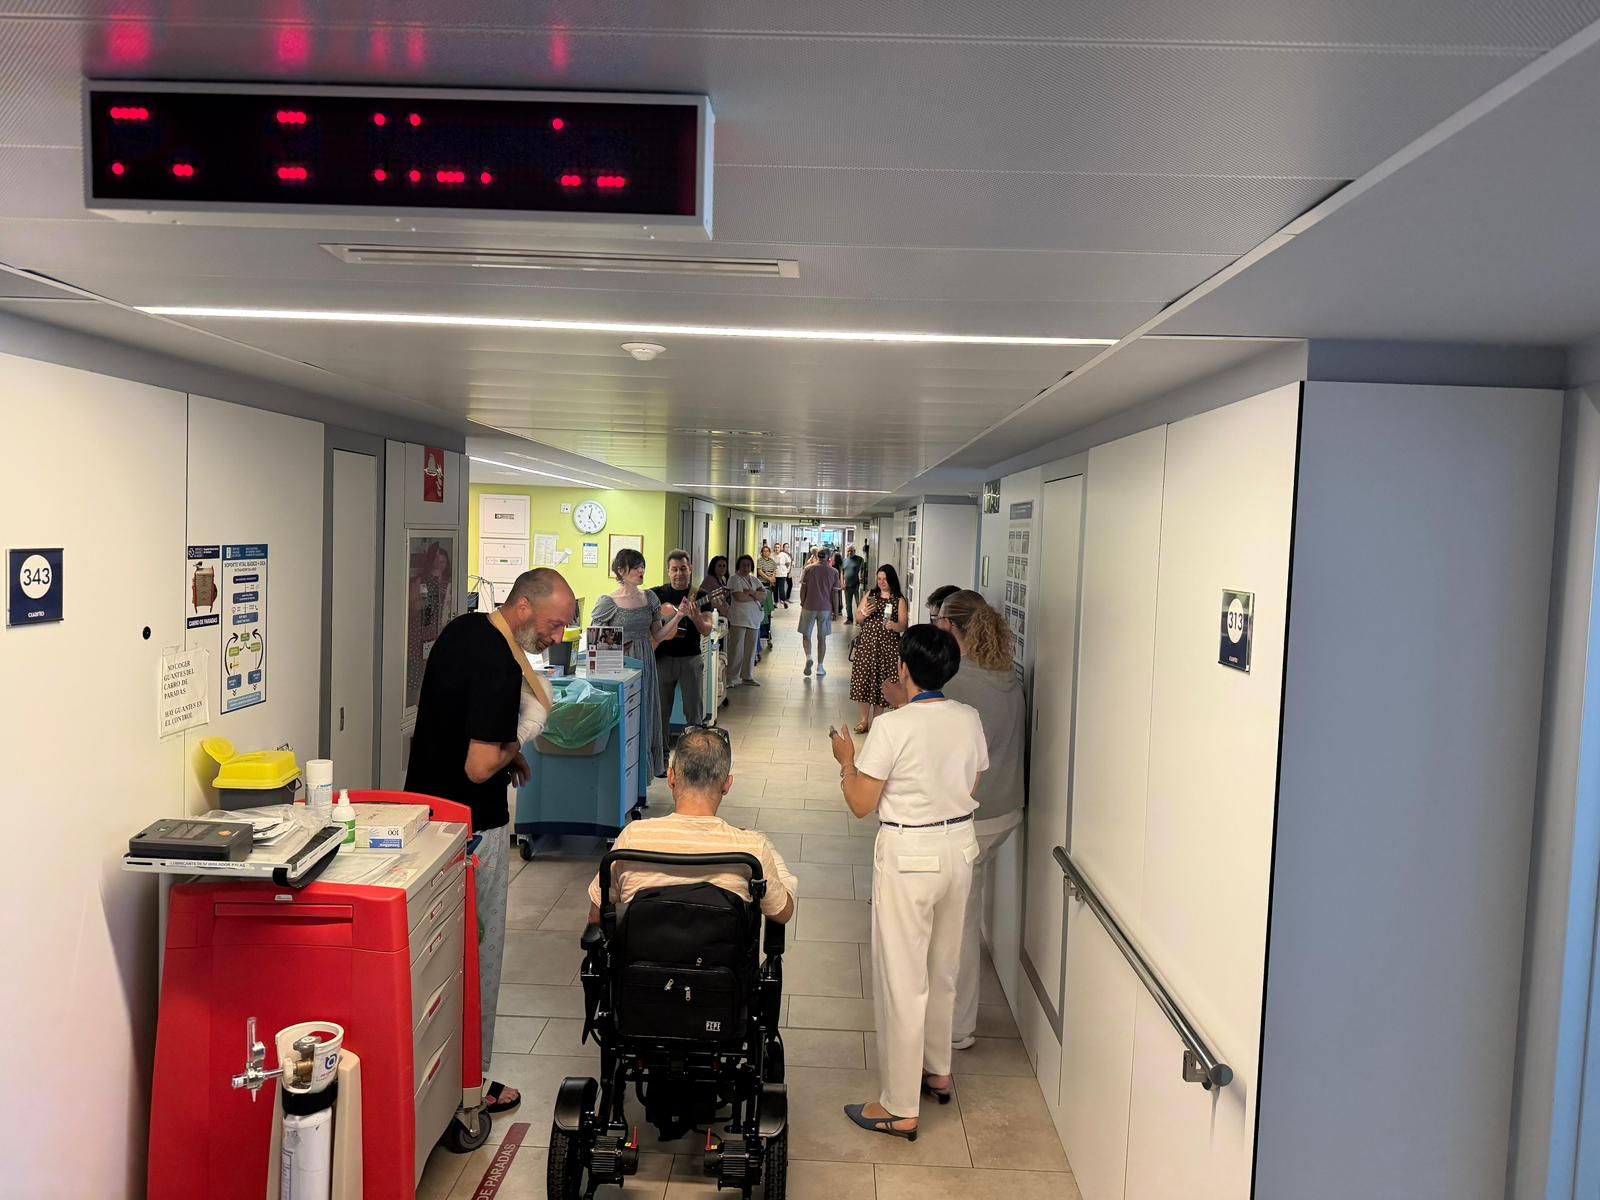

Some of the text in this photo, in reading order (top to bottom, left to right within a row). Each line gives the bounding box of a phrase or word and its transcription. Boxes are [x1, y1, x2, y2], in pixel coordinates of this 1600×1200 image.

[23, 567, 50, 586] 343
[1228, 611, 1243, 631] 313
[174, 660, 191, 669] COGER
[163, 671, 186, 681] GUANTES
[163, 682, 180, 691] CARRO
[174, 702, 196, 715] GUANTES
[484, 1143, 516, 1187] PARADAS
